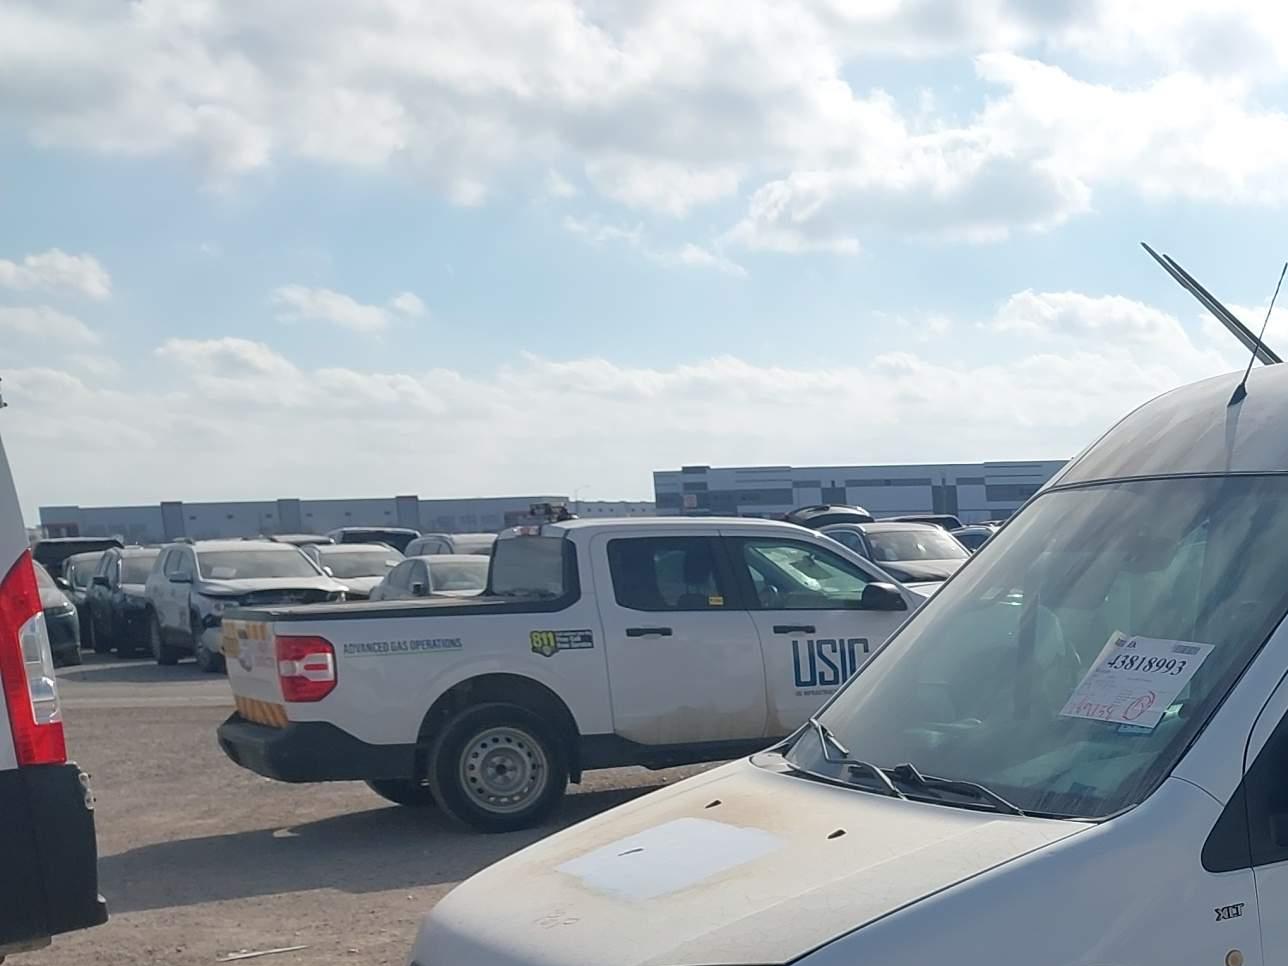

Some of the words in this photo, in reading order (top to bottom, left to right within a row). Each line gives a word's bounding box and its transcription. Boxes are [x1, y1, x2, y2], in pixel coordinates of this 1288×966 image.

[531, 631, 555, 649] 811
[1107, 653, 1187, 676] 43818993
[1214, 902, 1245, 921] XLT
